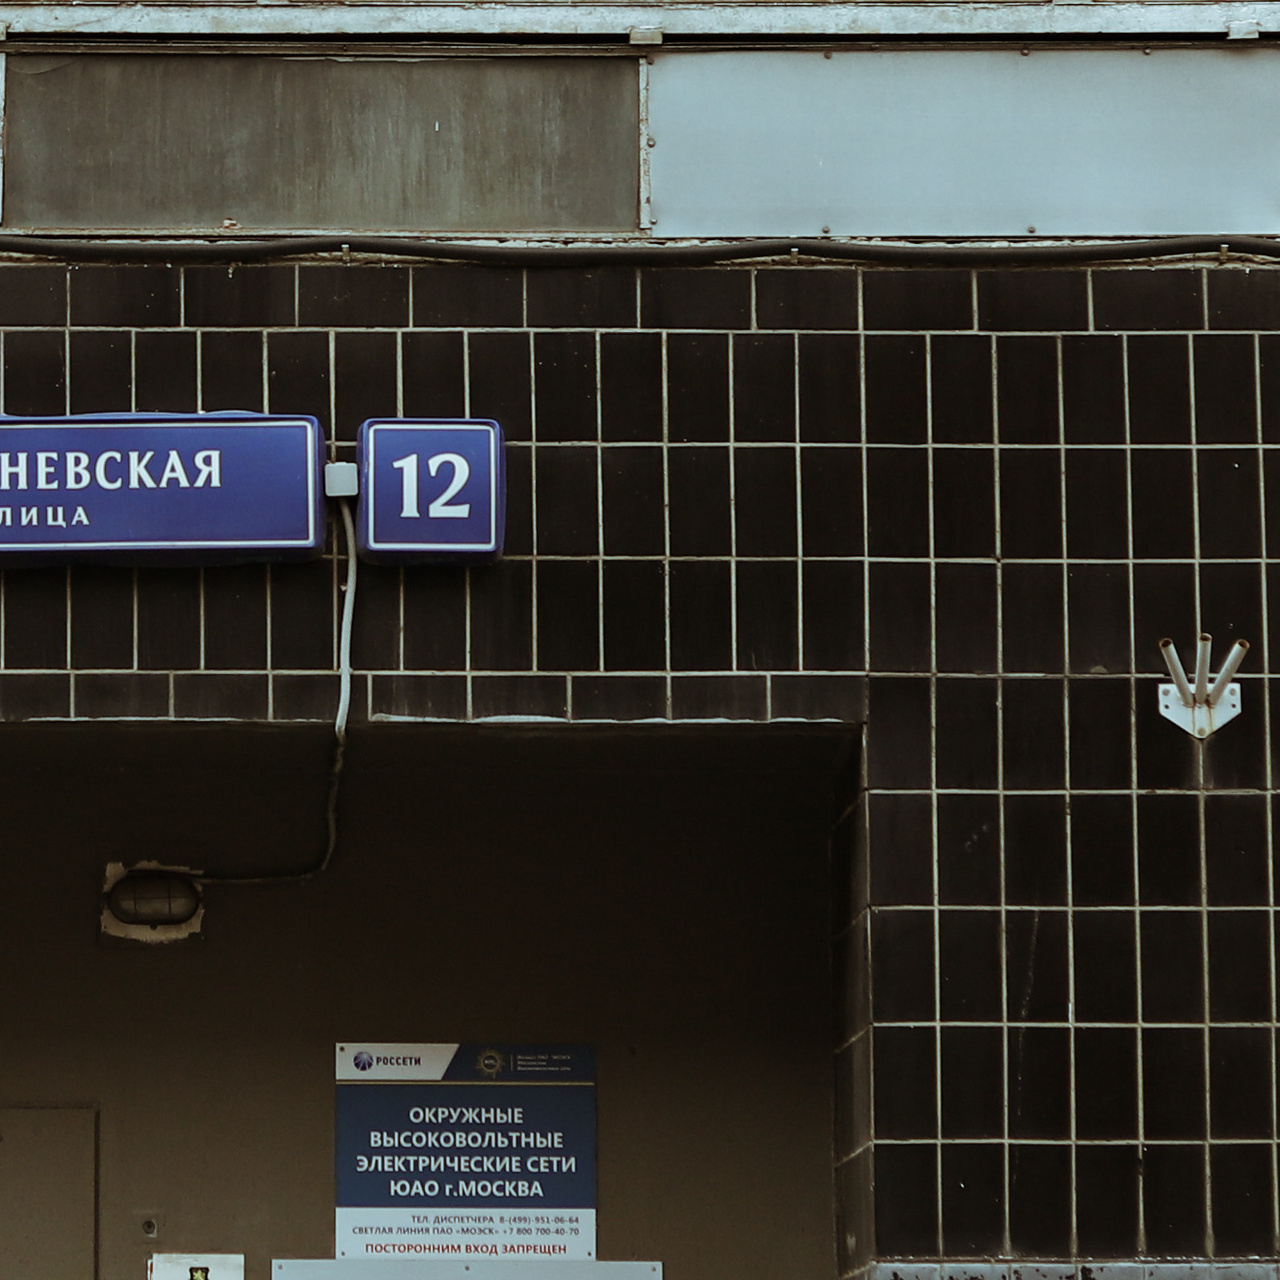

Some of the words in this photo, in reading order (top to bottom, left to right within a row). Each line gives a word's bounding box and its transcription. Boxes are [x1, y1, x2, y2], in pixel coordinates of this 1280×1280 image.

[392, 453, 472, 520] 12
[376, 1056, 421, 1066] РОССЕТИ
[410, 1108, 523, 1124] ОКРУЖНЫЕ
[370, 1132, 563, 1148] ВЫСОКОВОЛЬТНЫЕ
[356, 1156, 521, 1172] ЭЛЕКТРИЧЕСКИЕ
[527, 1157, 576, 1172] СЕТИ
[390, 1181, 439, 1197] ЮАО
[412, 1216, 430, 1224] ТЕЛ.
[433, 1216, 494, 1225] ДИСПЕТЧЕРА
[352, 1227, 393, 1235] СВЕТЛАЯ
[396, 1227, 430, 1235] ЛИНИЯ
[433, 1227, 453, 1235] ПАО
[365, 1244, 461, 1254] ПОСТОРОННИМ
[466, 1244, 498, 1255] ВХОД
[502, 1245, 567, 1256] ЗАПРЕЩЕН
